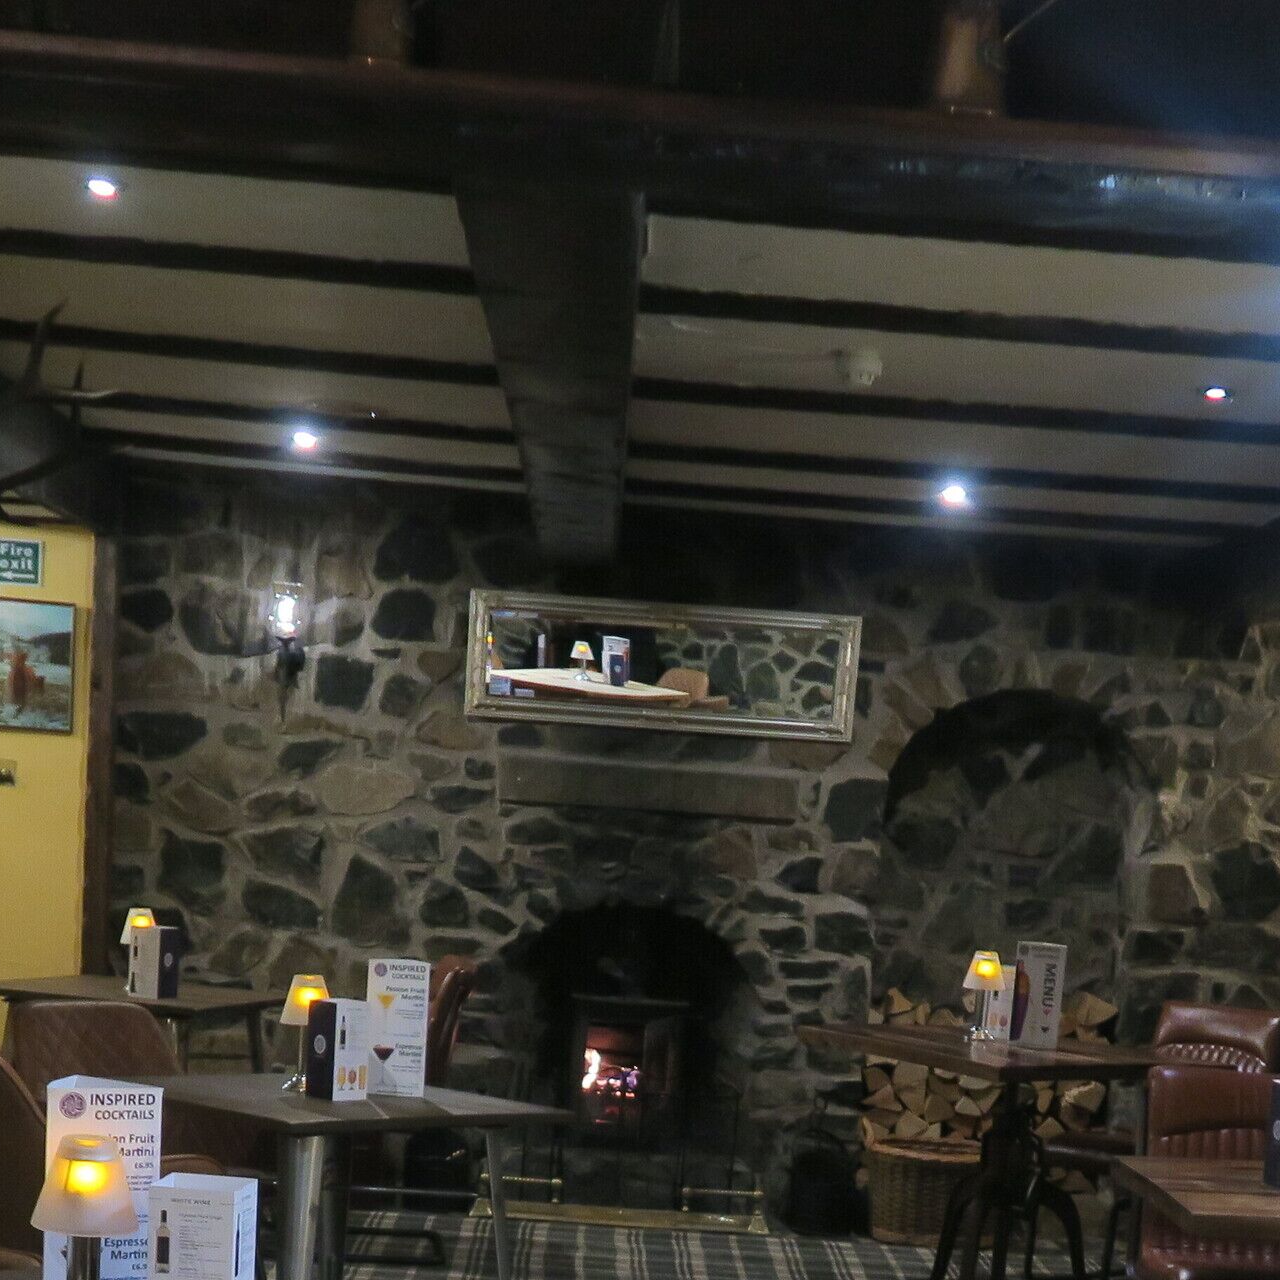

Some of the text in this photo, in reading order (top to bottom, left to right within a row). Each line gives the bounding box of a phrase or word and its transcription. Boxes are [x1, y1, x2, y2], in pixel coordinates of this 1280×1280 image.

[0, 542, 33, 558] Fire
[0, 557, 34, 571] exit
[390, 964, 426, 973] INSPIRED
[391, 973, 426, 981] COCKTAILS
[1041, 963, 1057, 1008] MENU
[90, 1093, 156, 1106] INSPIRED
[95, 1109, 155, 1120] COCKTAILS
[129, 1133, 155, 1144] Fruit
